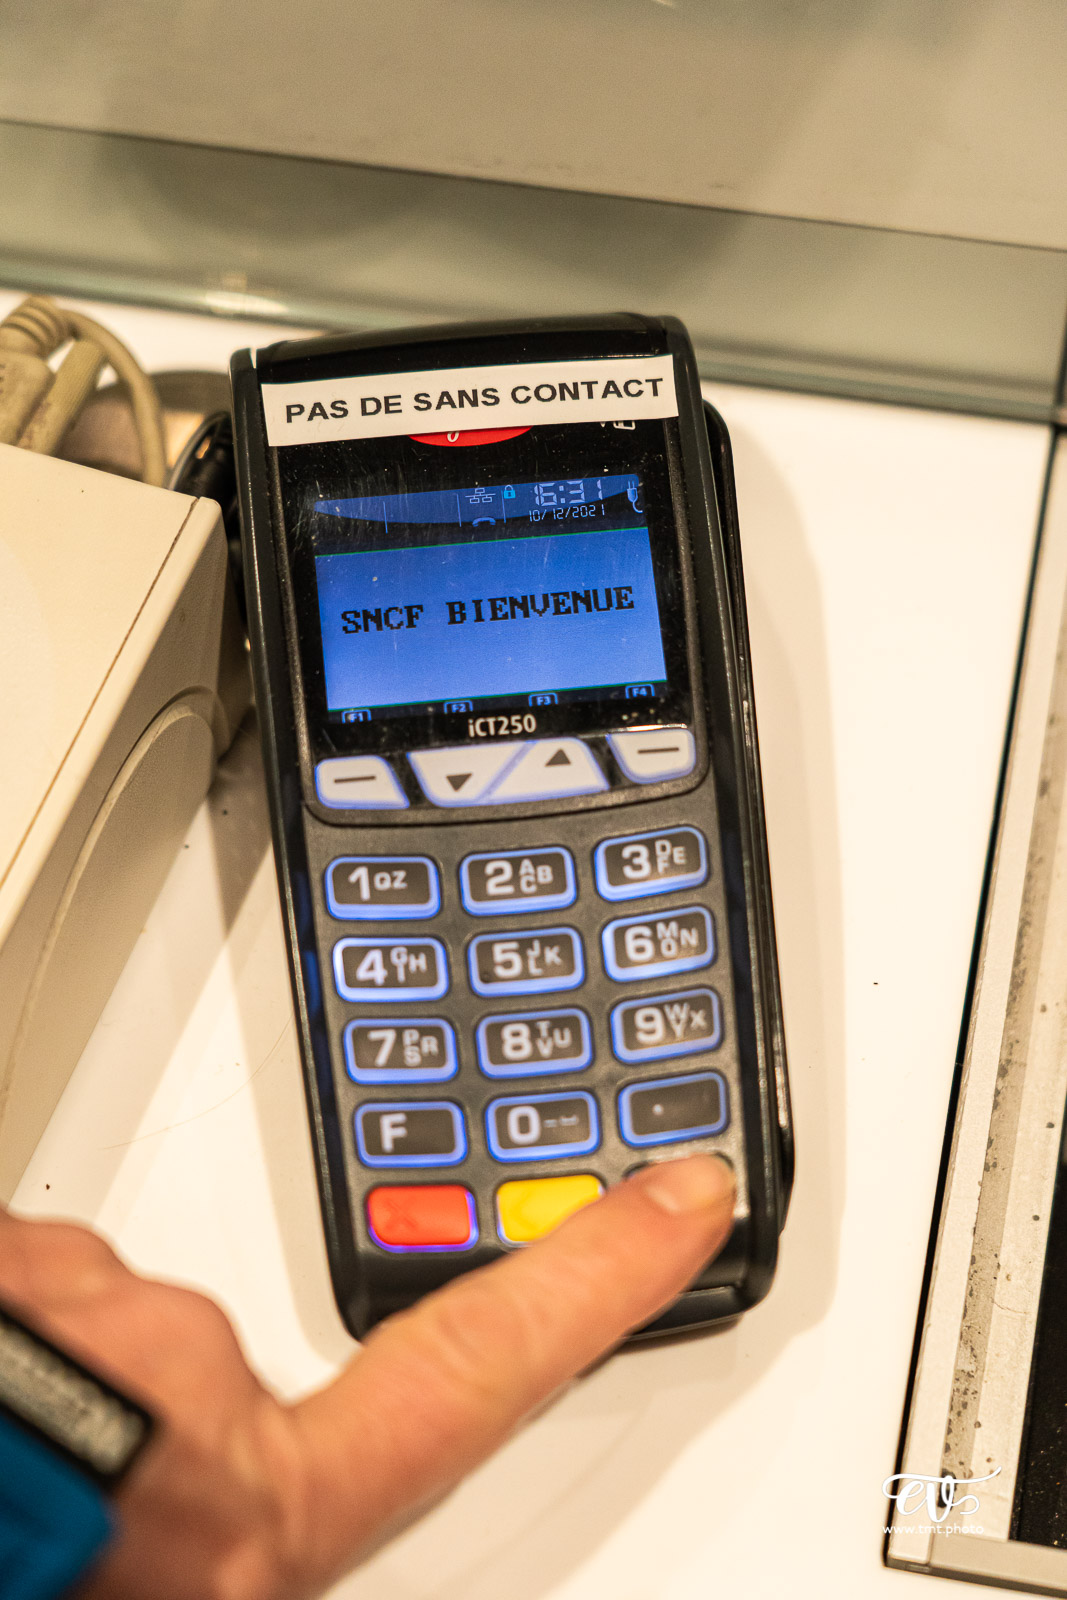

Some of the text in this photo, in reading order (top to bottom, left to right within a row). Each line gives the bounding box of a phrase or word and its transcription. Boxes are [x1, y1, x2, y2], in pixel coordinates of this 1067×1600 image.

[285, 378, 664, 423] PAS DE SANS CONTACT
[533, 479, 603, 506] 16:31
[528, 503, 605, 522] 10/12/2021
[341, 586, 635, 634] SNCF BIENVENUE
[451, 703, 467, 713] F2
[536, 695, 551, 706] F3
[631, 687, 647, 698] F4
[467, 713, 537, 738] iCT250
[485, 860, 514, 896] 2
[622, 844, 651, 880] 3
[348, 866, 370, 901] 1
[491, 941, 522, 978] 5
[624, 925, 654, 962] 6
[356, 949, 387, 986] 4
[501, 1022, 532, 1061] 8
[634, 1007, 665, 1044] 9
[368, 1029, 396, 1067] 7
[380, 1112, 407, 1153] F
[507, 1105, 541, 1145] 0
